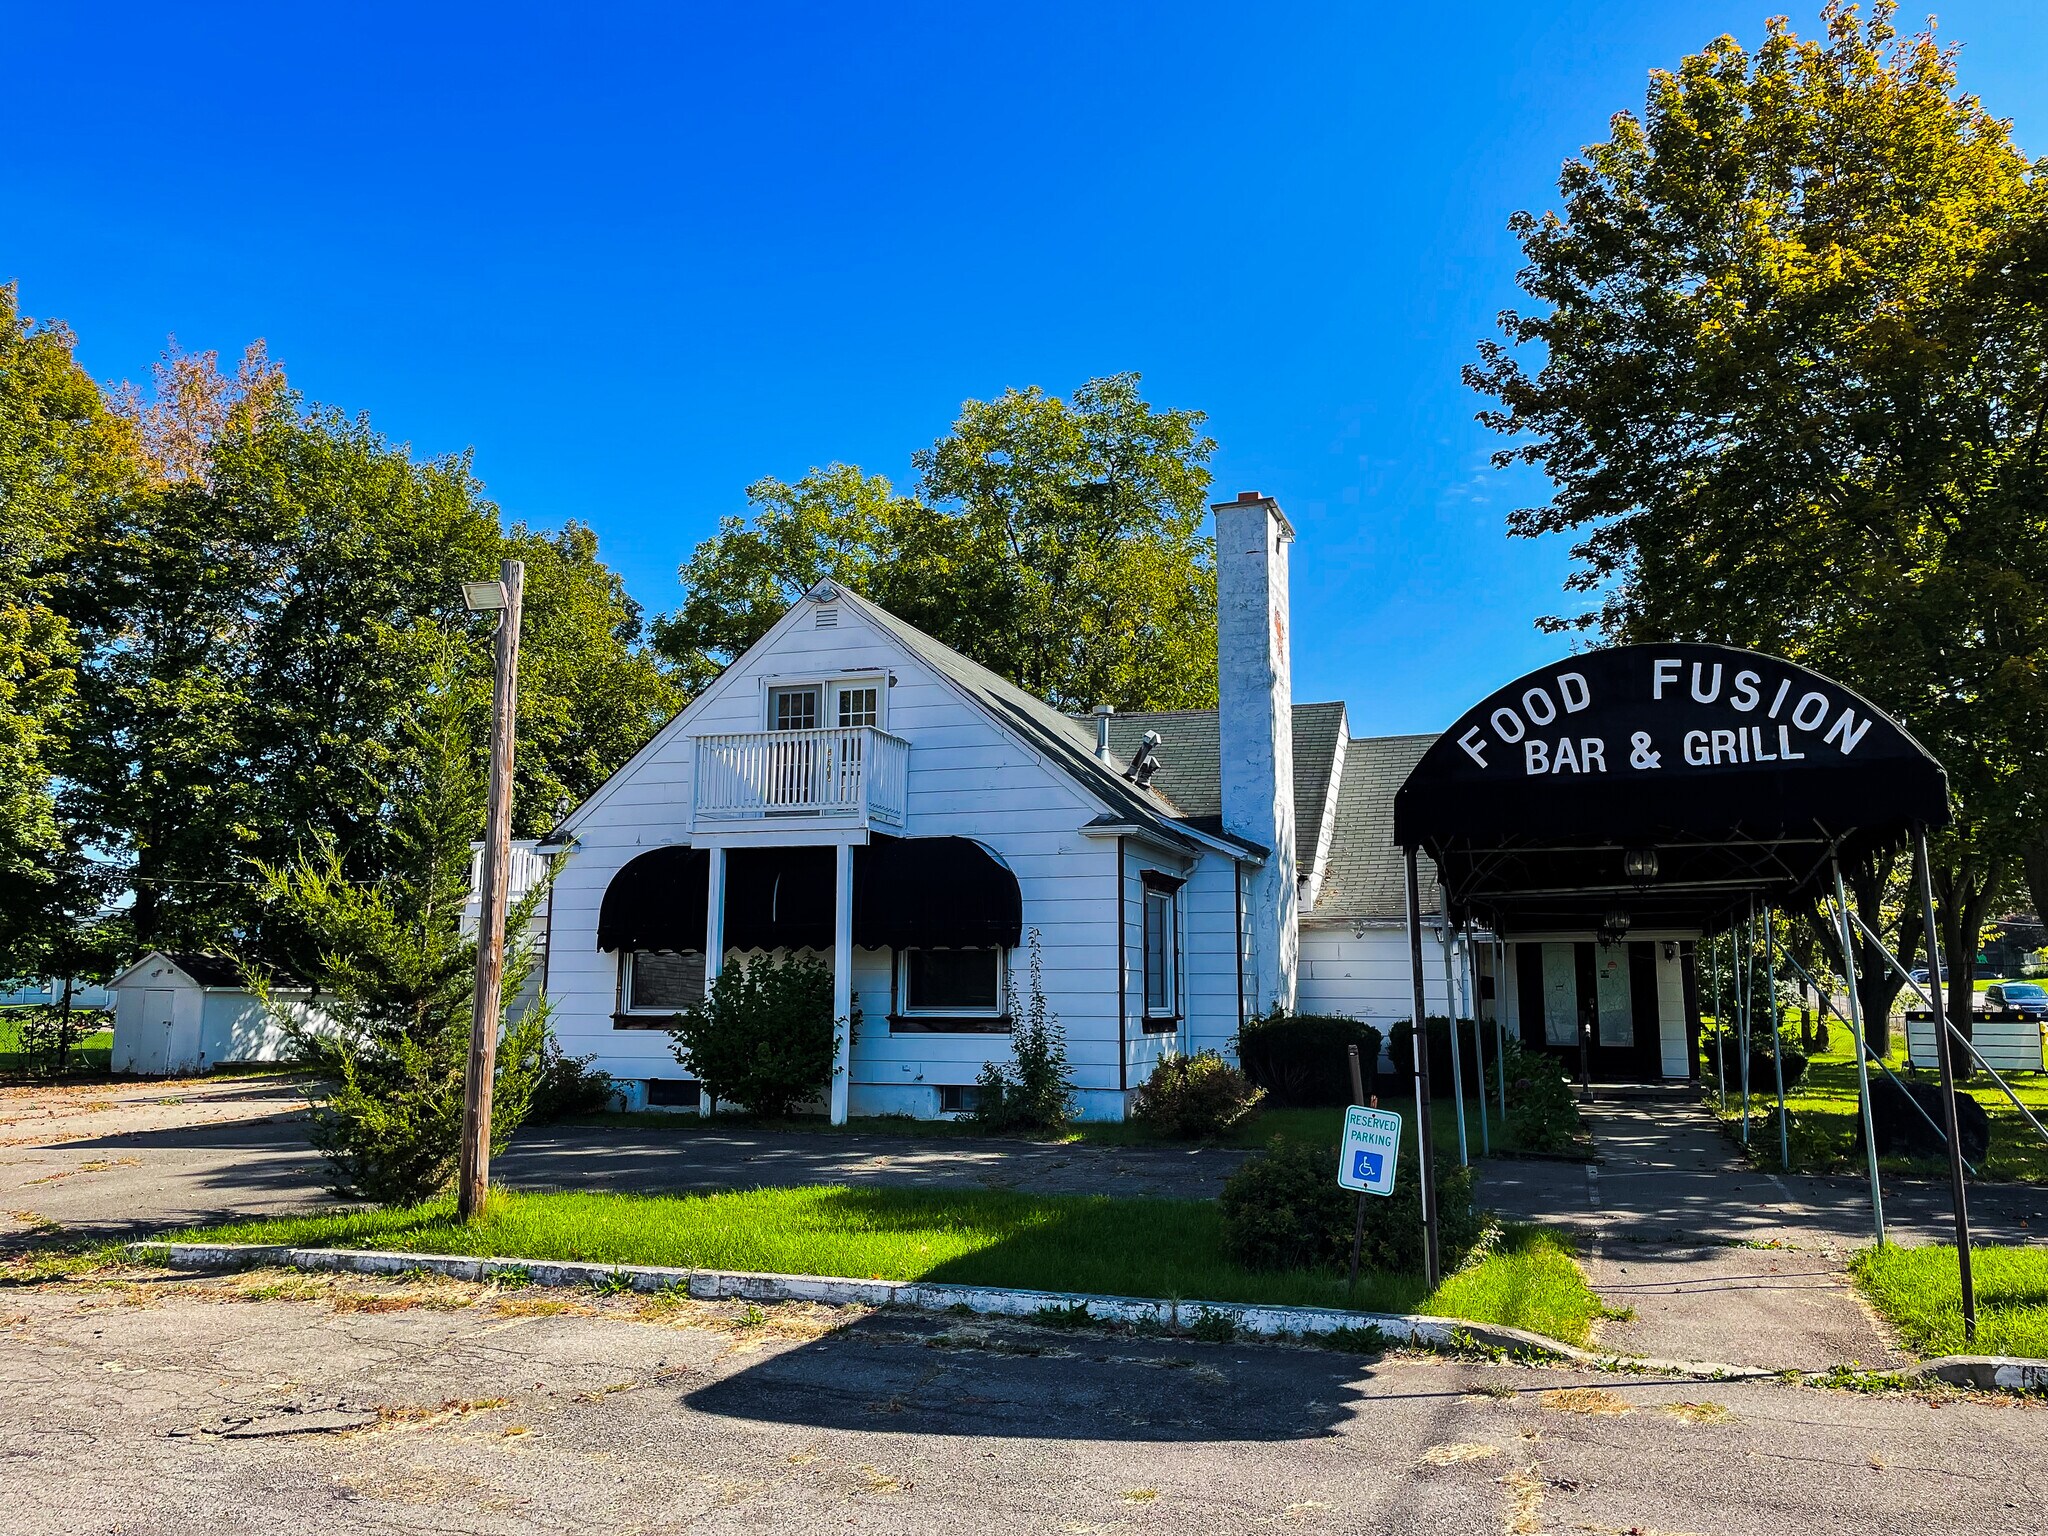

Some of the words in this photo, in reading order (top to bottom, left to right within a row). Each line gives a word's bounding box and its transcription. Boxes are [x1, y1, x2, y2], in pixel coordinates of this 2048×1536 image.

[1457, 672, 1591, 769] FOOD
[1653, 659, 1873, 756] FUSION
[1525, 737, 1608, 776] BAR
[1630, 731, 1662, 770] &
[1684, 724, 1805, 767] GRILL
[1349, 1113, 1397, 1132] RESERVED
[1350, 1130, 1392, 1147] PARKING
